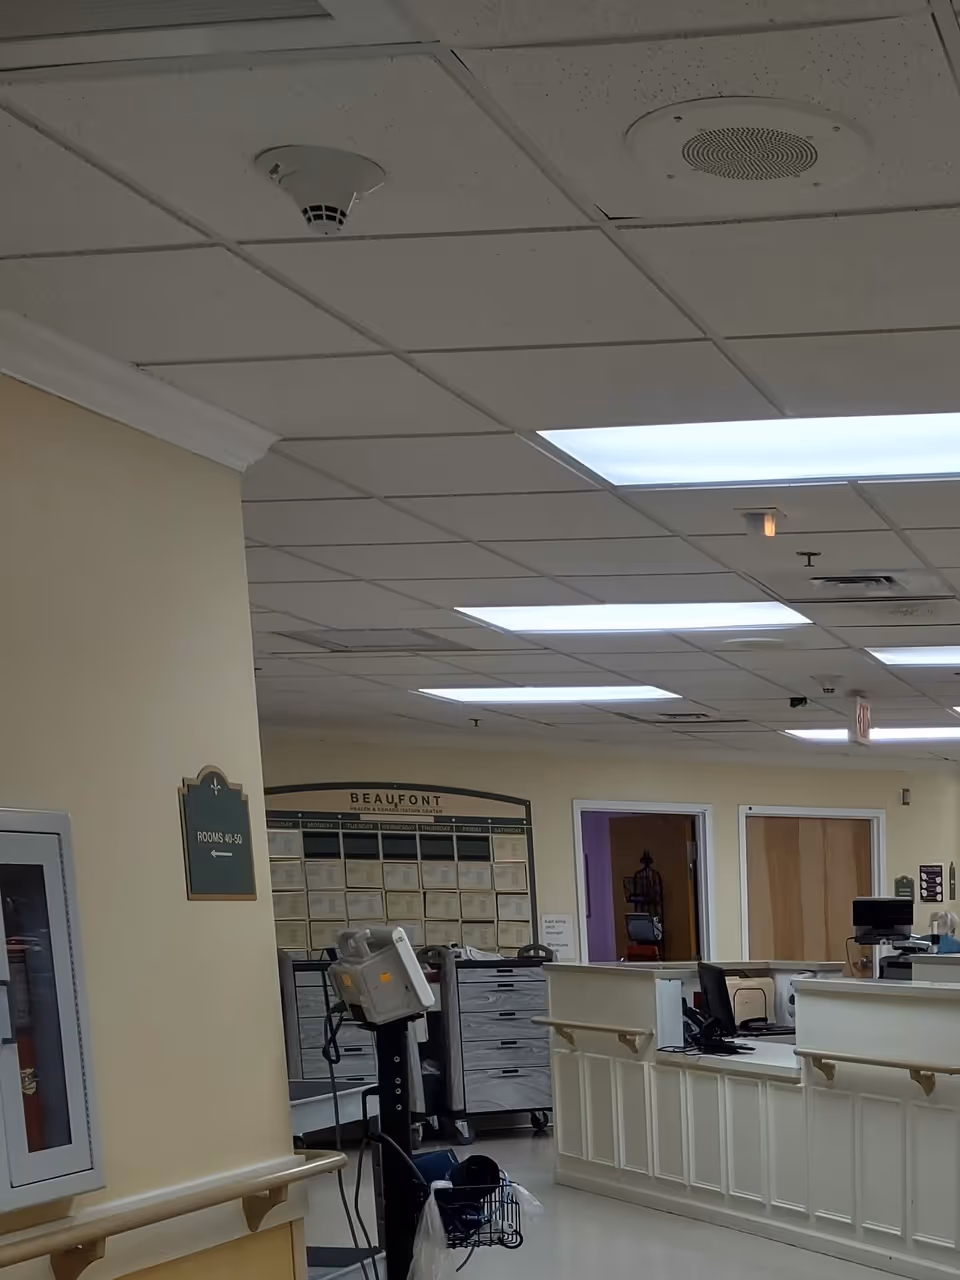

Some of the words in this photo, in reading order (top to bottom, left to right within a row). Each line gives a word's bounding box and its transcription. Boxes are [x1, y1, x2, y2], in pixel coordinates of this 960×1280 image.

[350, 792, 441, 806] BEAUFONT
[197, 831, 224, 843] ROOMS
[224, 834, 243, 844] 40-50
